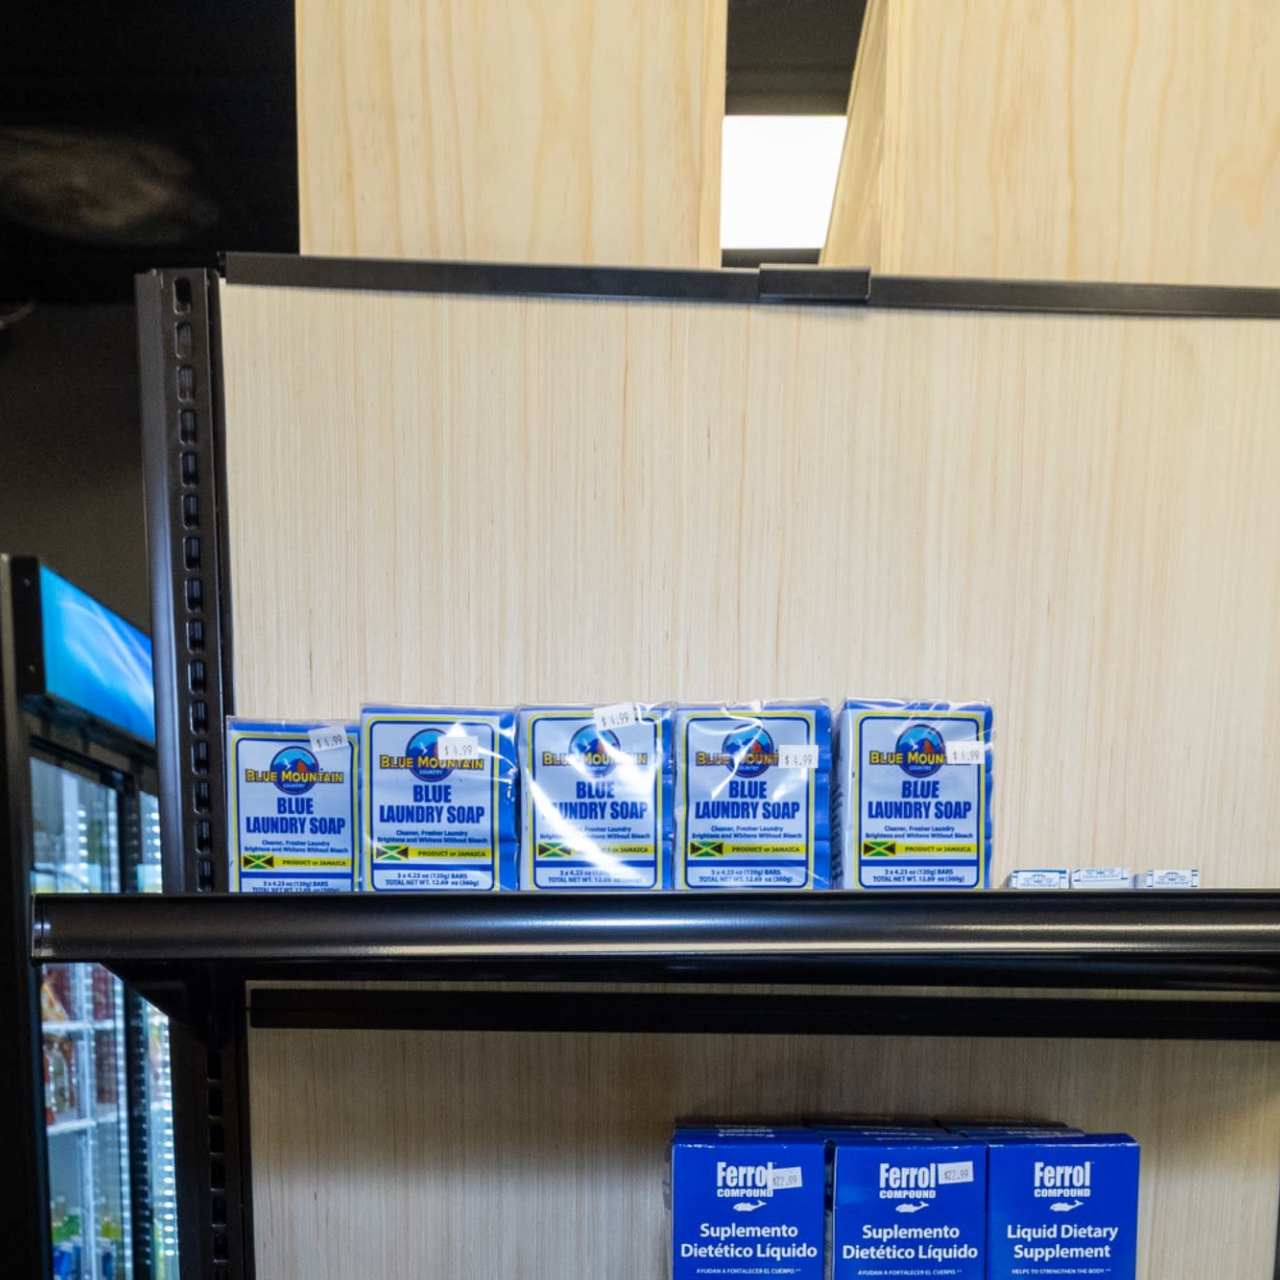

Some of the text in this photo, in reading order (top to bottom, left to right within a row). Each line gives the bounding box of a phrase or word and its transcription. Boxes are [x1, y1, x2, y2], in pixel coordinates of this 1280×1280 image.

[380, 755, 413, 769] BLUE
[870, 751, 903, 765] BLUE
[245, 769, 344, 783] BLUE MOUNTAIN
[413, 785, 451, 802] BLUE
[576, 781, 615, 799] BLUE
[729, 781, 767, 799] BLUE
[902, 781, 940, 798] BLUE
[277, 798, 313, 814] BLUE
[380, 806, 484, 823] LAUNDRY SOAP
[611, 802, 648, 820] SOAP
[695, 802, 800, 819] LAUNDRY SOAP
[868, 801, 972, 819] LAUNDRY SOAP
[246, 817, 346, 834] LAUNDRY SOAP
[717, 1162, 773, 1187] Ferrol
[880, 1163, 936, 1188] Ferrol
[1034, 1162, 1090, 1187] Ferrol
[717, 1189, 773, 1197] COMPOUND
[880, 1190, 936, 1199] COMPOUND
[1034, 1189, 1091, 1197] COMPOUND
[700, 1223, 798, 1240] Suplemento
[862, 1225, 960, 1241] Suplemento
[1007, 1225, 1118, 1241] Liquid Dietary
[681, 1244, 817, 1261] Dietético Líquido
[843, 1244, 978, 1261] Dietético Líquido
[1014, 1245, 1111, 1261] Supplement
